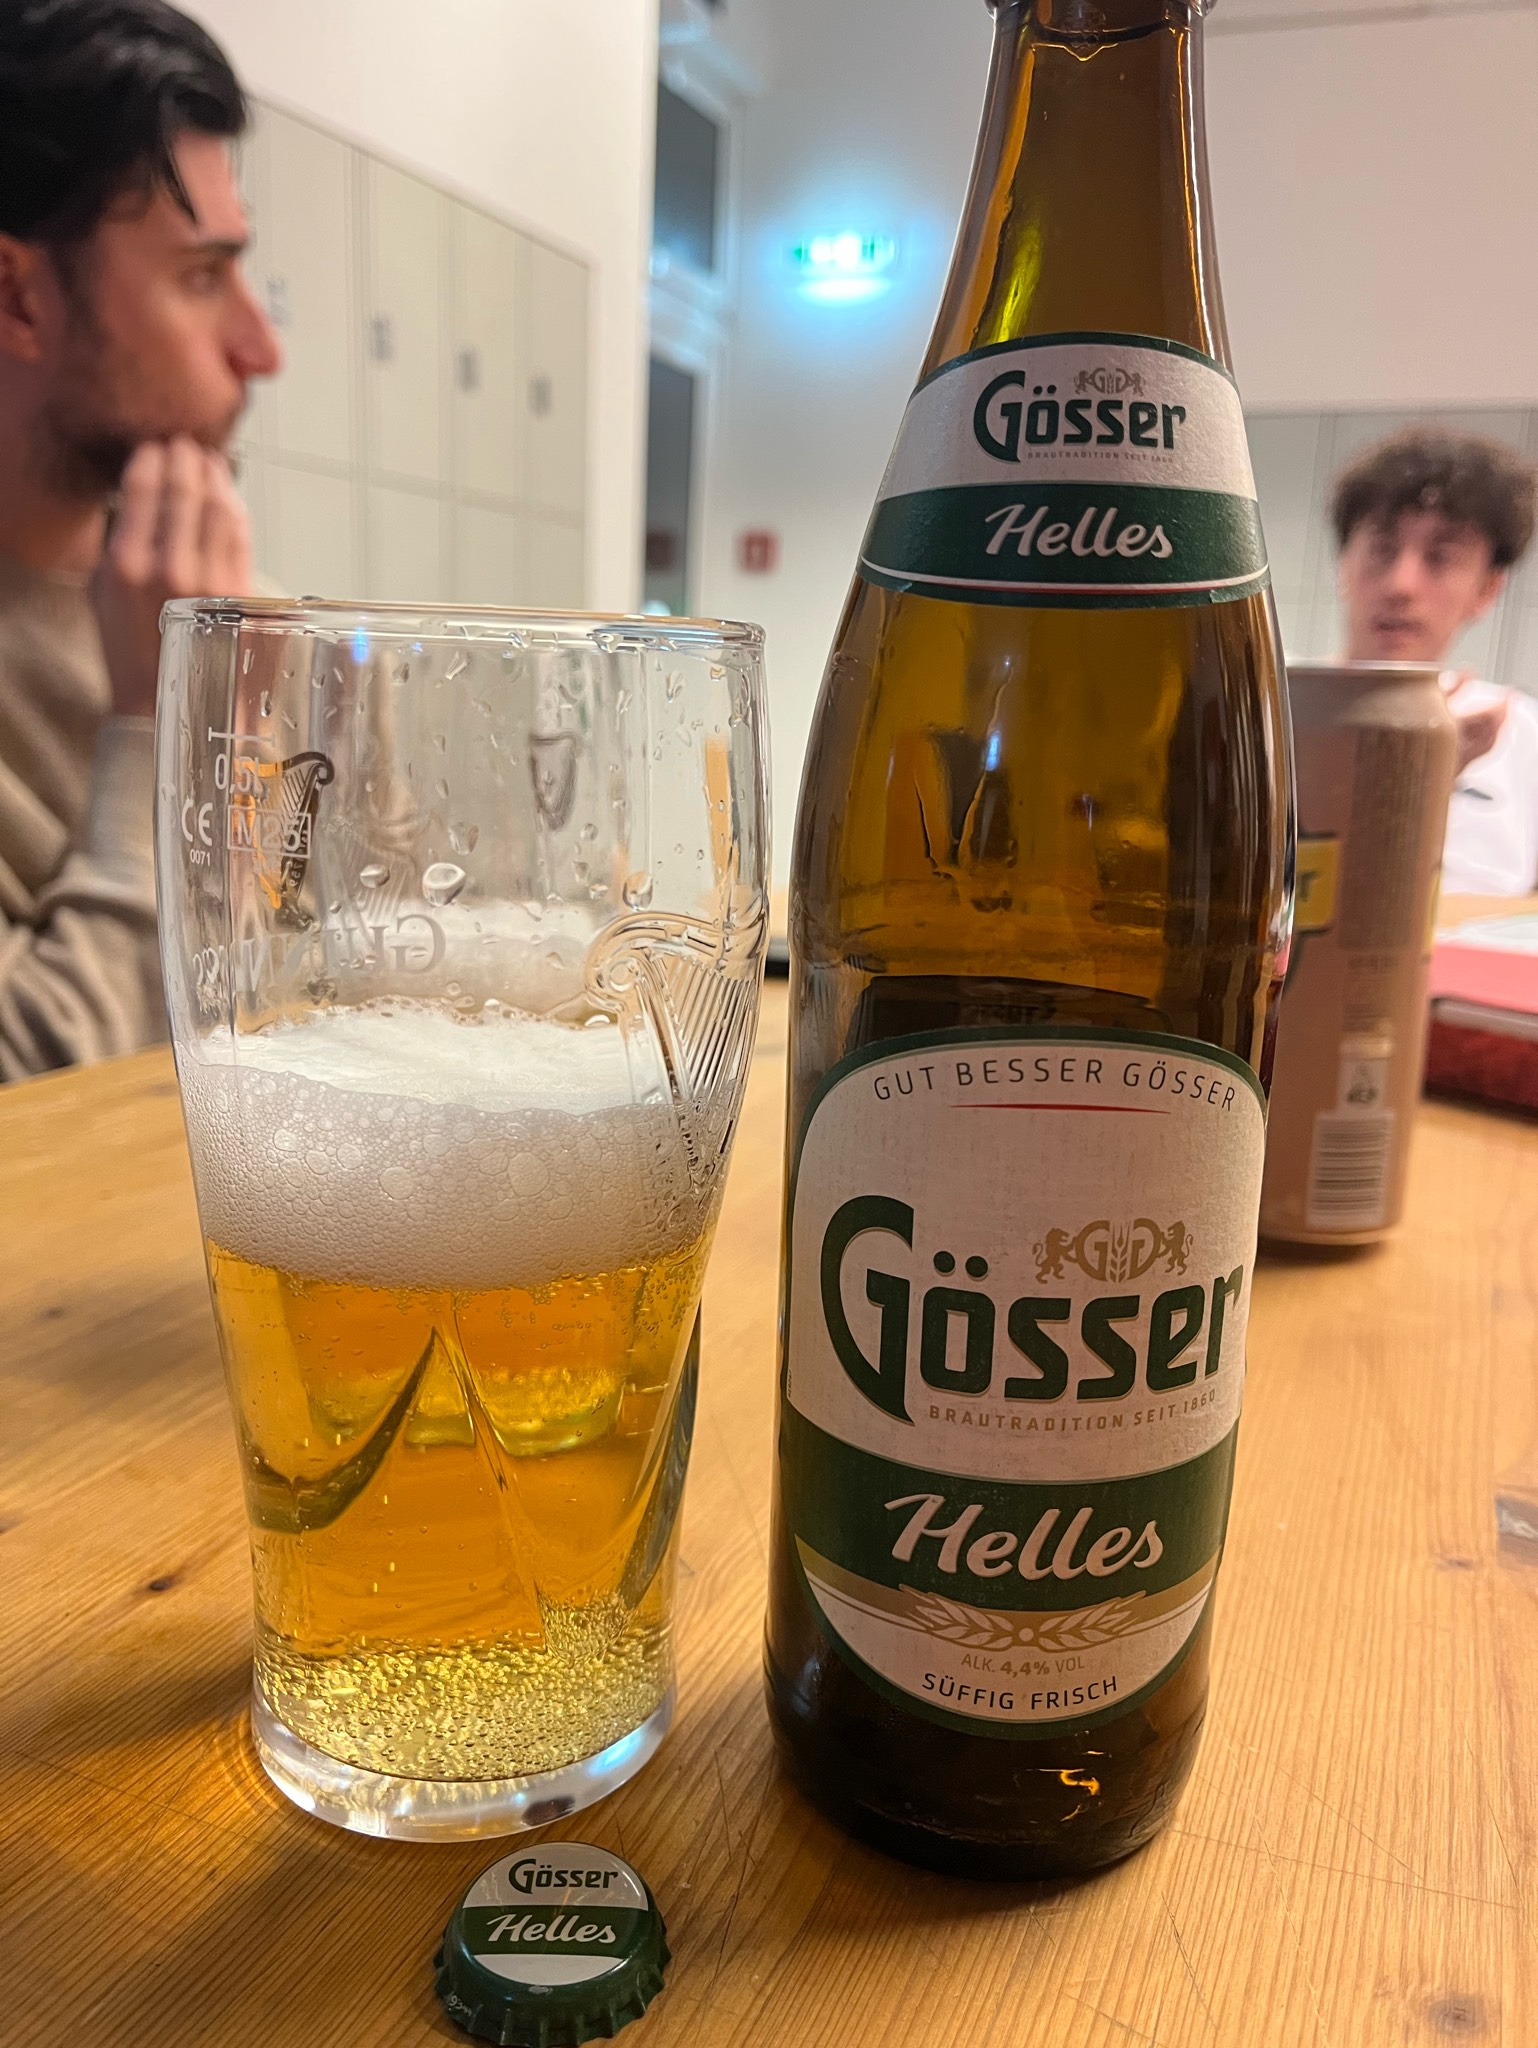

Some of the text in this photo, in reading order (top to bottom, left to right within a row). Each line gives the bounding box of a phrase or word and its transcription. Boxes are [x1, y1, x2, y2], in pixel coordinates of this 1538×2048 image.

[973, 370, 1187, 463] Gösser
[1027, 451, 1120, 460] BRAUTRADITION
[984, 504, 1173, 559] Helles
[189, 848, 212, 867] 0071
[873, 1057, 1237, 1112] GUT BESSER GÖSSER
[820, 1195, 1244, 1426] Gösser
[929, 1388, 1215, 1432] BRAUTRADITION SEIT 1860
[884, 1493, 1164, 1581] Helles
[960, 1653, 1085, 1678] ALK. 4,4% VOL
[921, 1673, 1118, 1711] SÜFFIG FRISCH
[508, 1858, 619, 1895] Gösser
[486, 1913, 617, 1945] Helles
